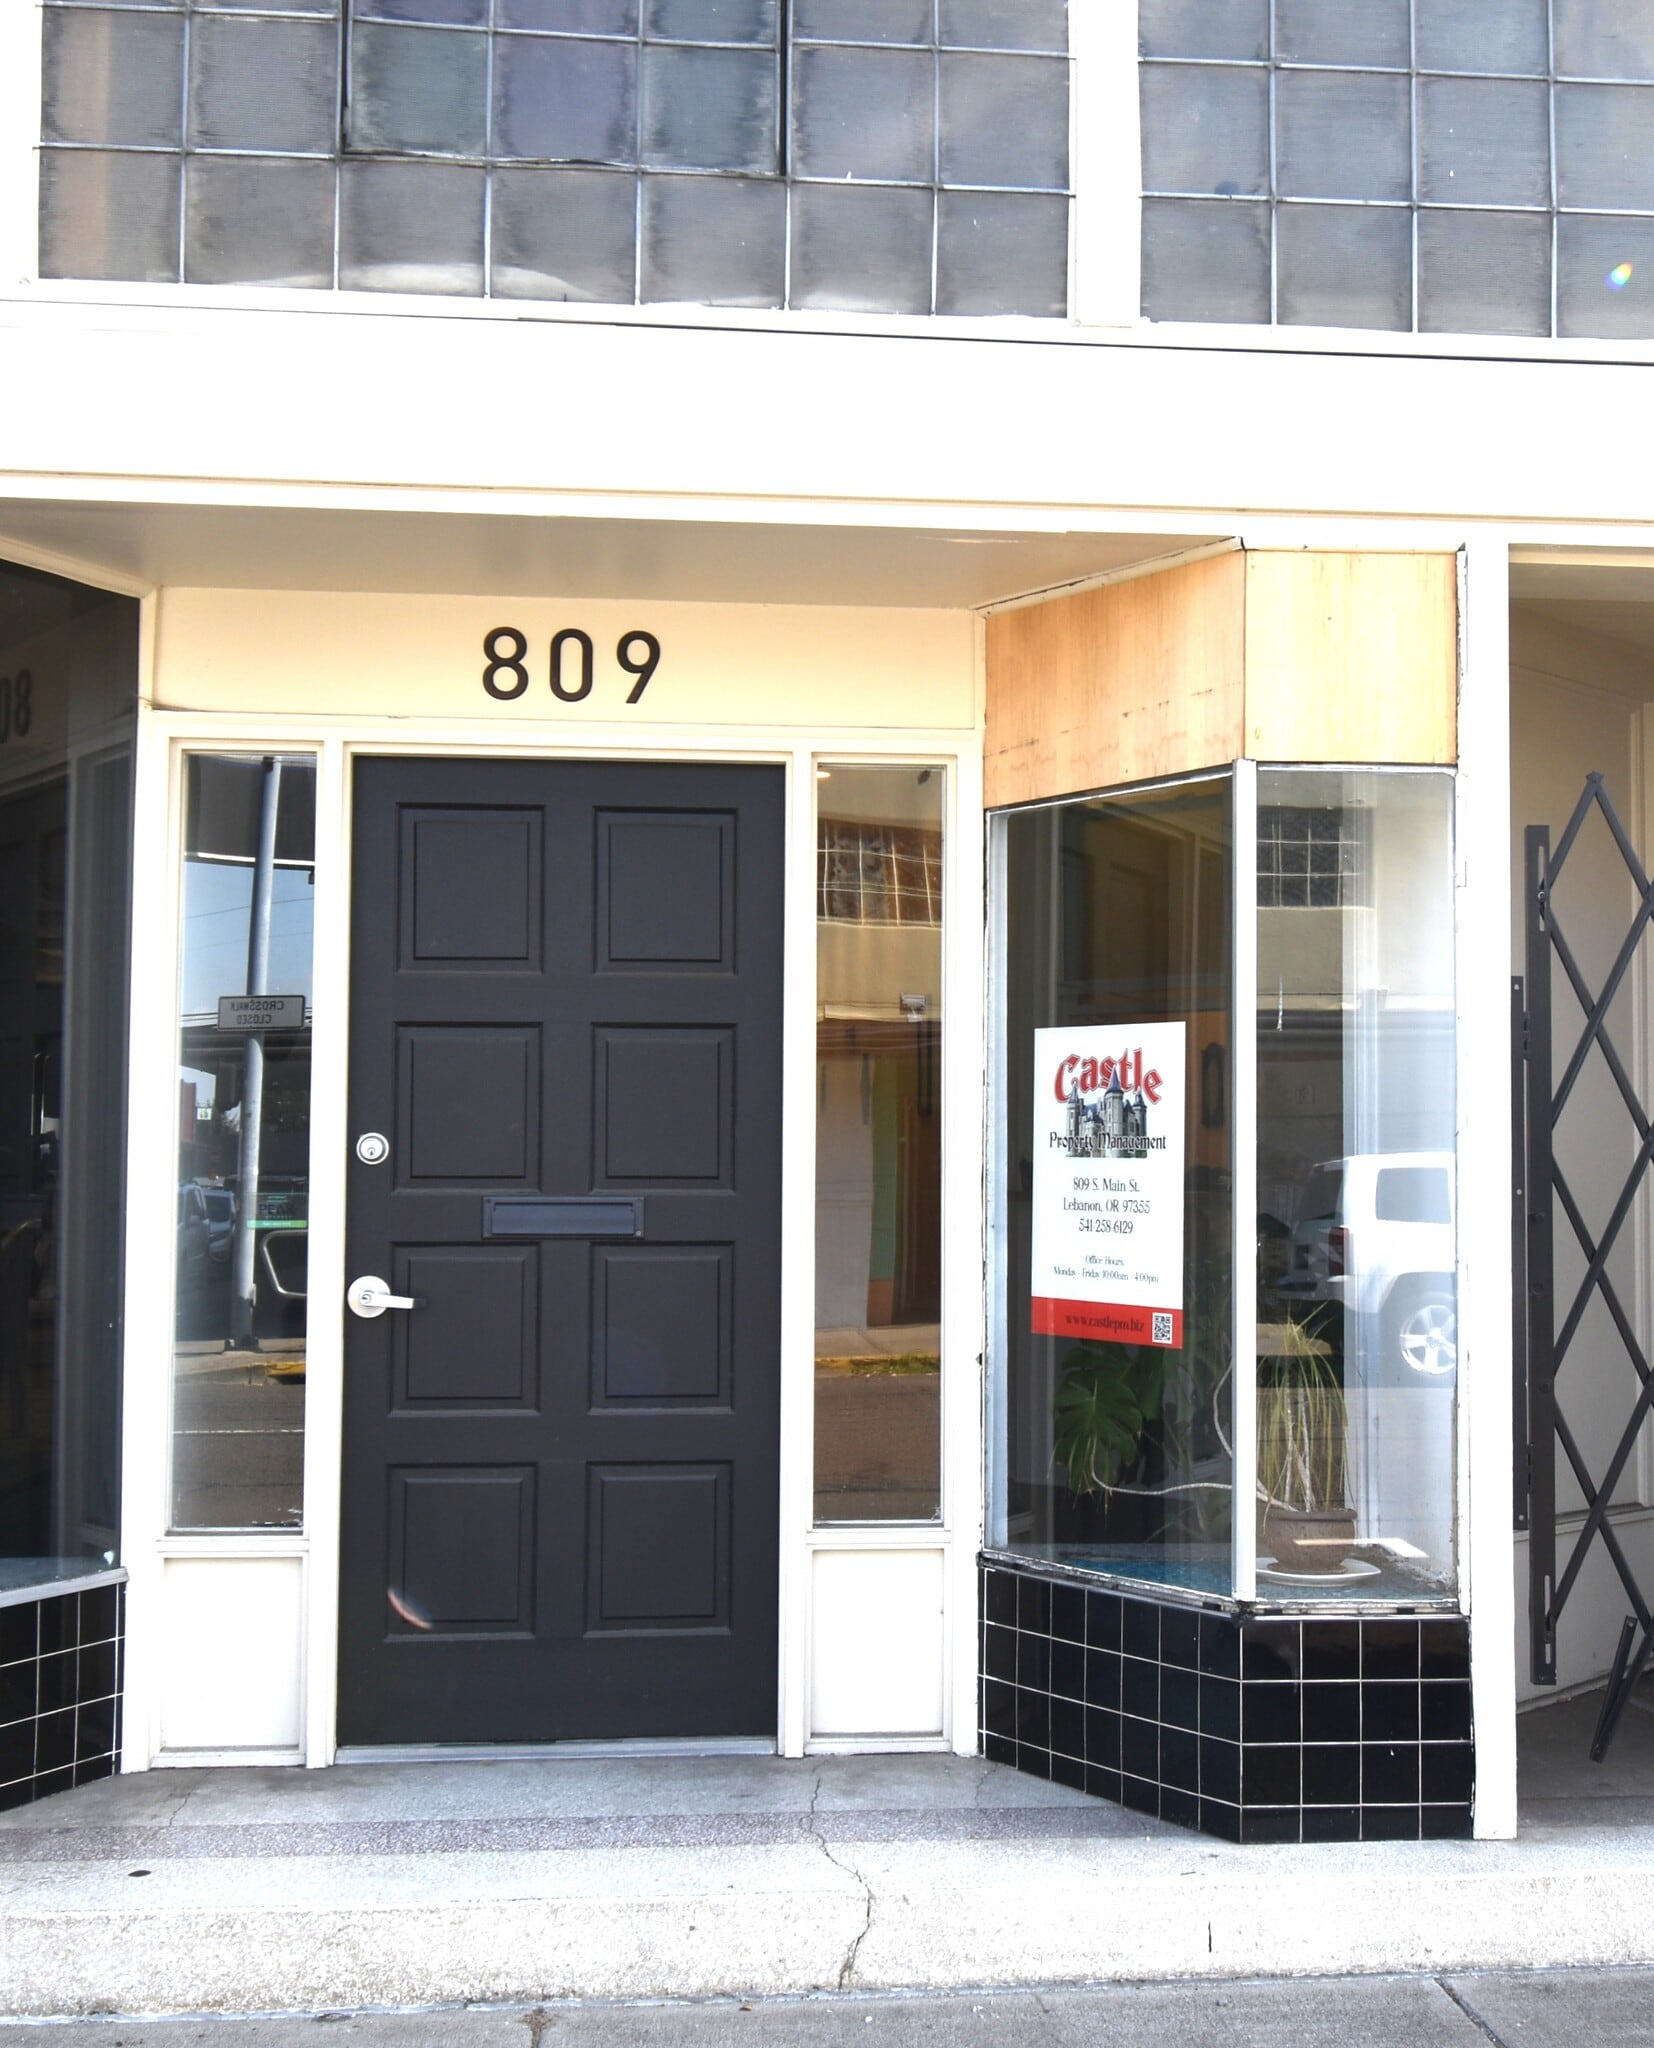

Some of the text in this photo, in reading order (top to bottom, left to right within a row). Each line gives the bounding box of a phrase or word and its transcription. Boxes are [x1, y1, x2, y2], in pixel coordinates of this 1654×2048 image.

[482, 626, 661, 704] 809
[1054, 1047, 1163, 1105] Castle
[1049, 1131, 1167, 1152] Property Management
[1073, 1177, 1090, 1191] 809
[1102, 1178, 1127, 1192] Main
[1063, 1197, 1151, 1214] Lebanon, OR 97355
[1078, 1218, 1134, 1234] 541-258-6129
[1085, 1255, 1102, 1265] Office
[1053, 1266, 1076, 1280] Monday
[1082, 1268, 1099, 1281] Friday
[1065, 1314, 1144, 1333] www.castlepm.biz
